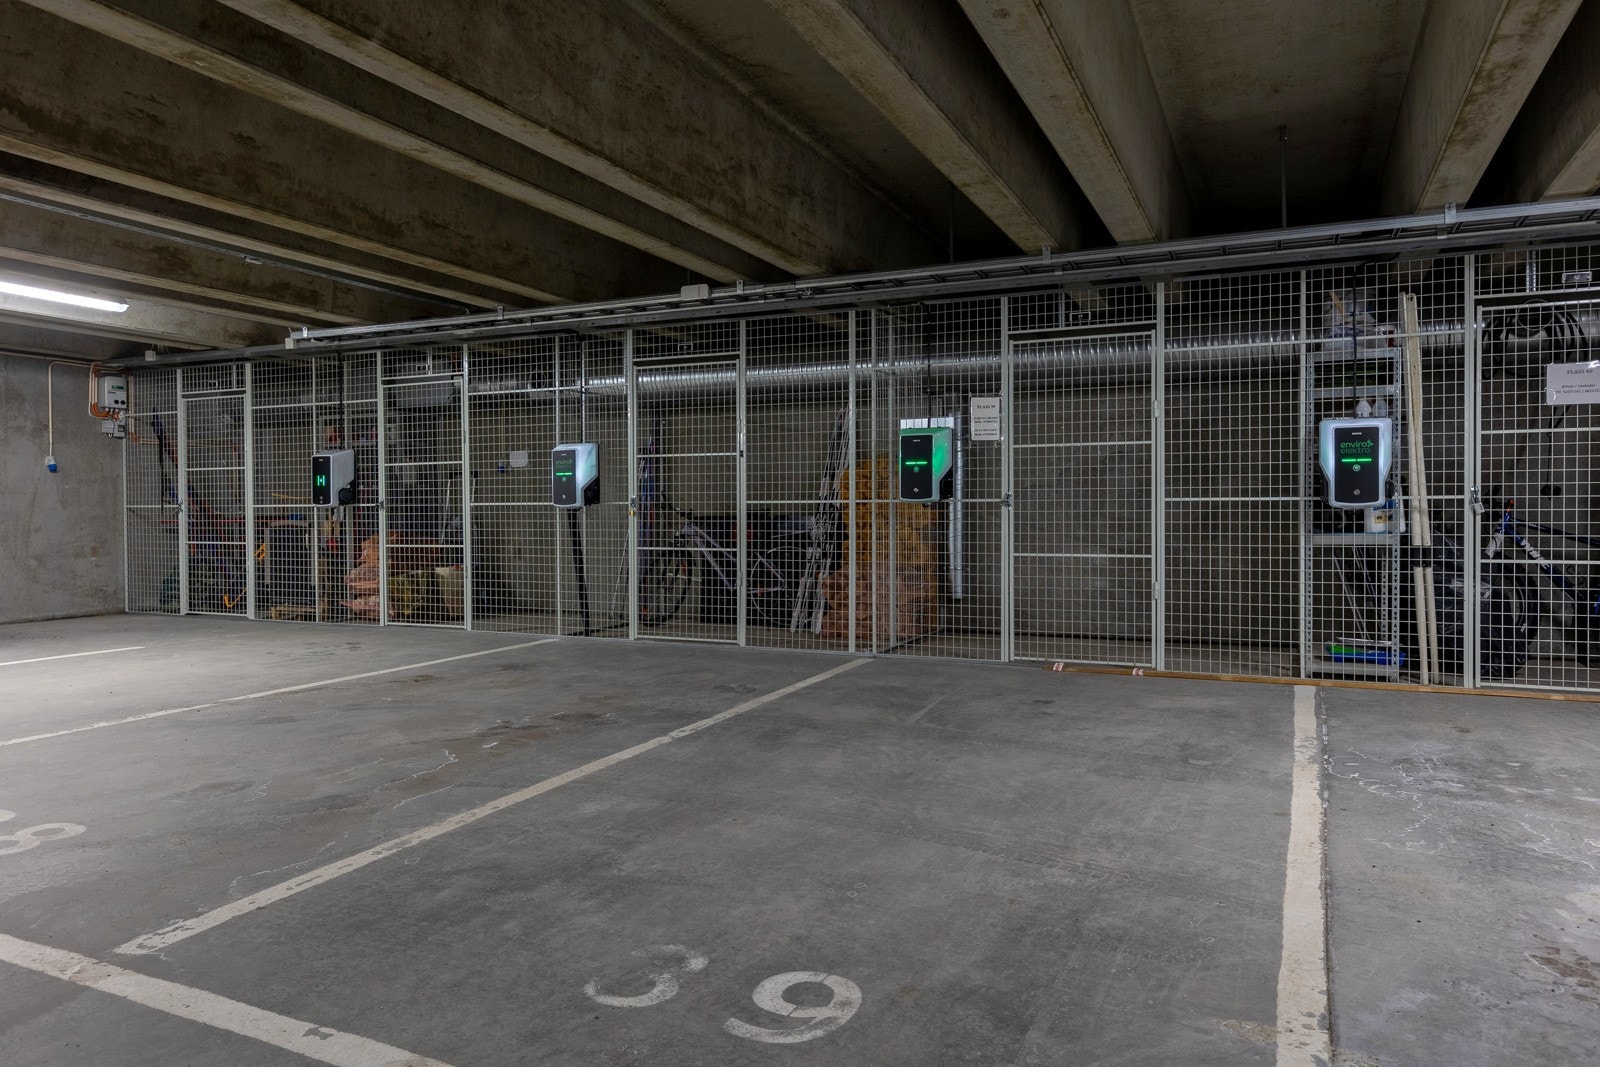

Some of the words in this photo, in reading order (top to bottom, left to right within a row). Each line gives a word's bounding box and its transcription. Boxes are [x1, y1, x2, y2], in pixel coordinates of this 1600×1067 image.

[1340, 440, 1368, 448] enviro
[1340, 447, 1371, 455] elektro
[0, 809, 88, 855] 8
[583, 943, 864, 1044] 39
